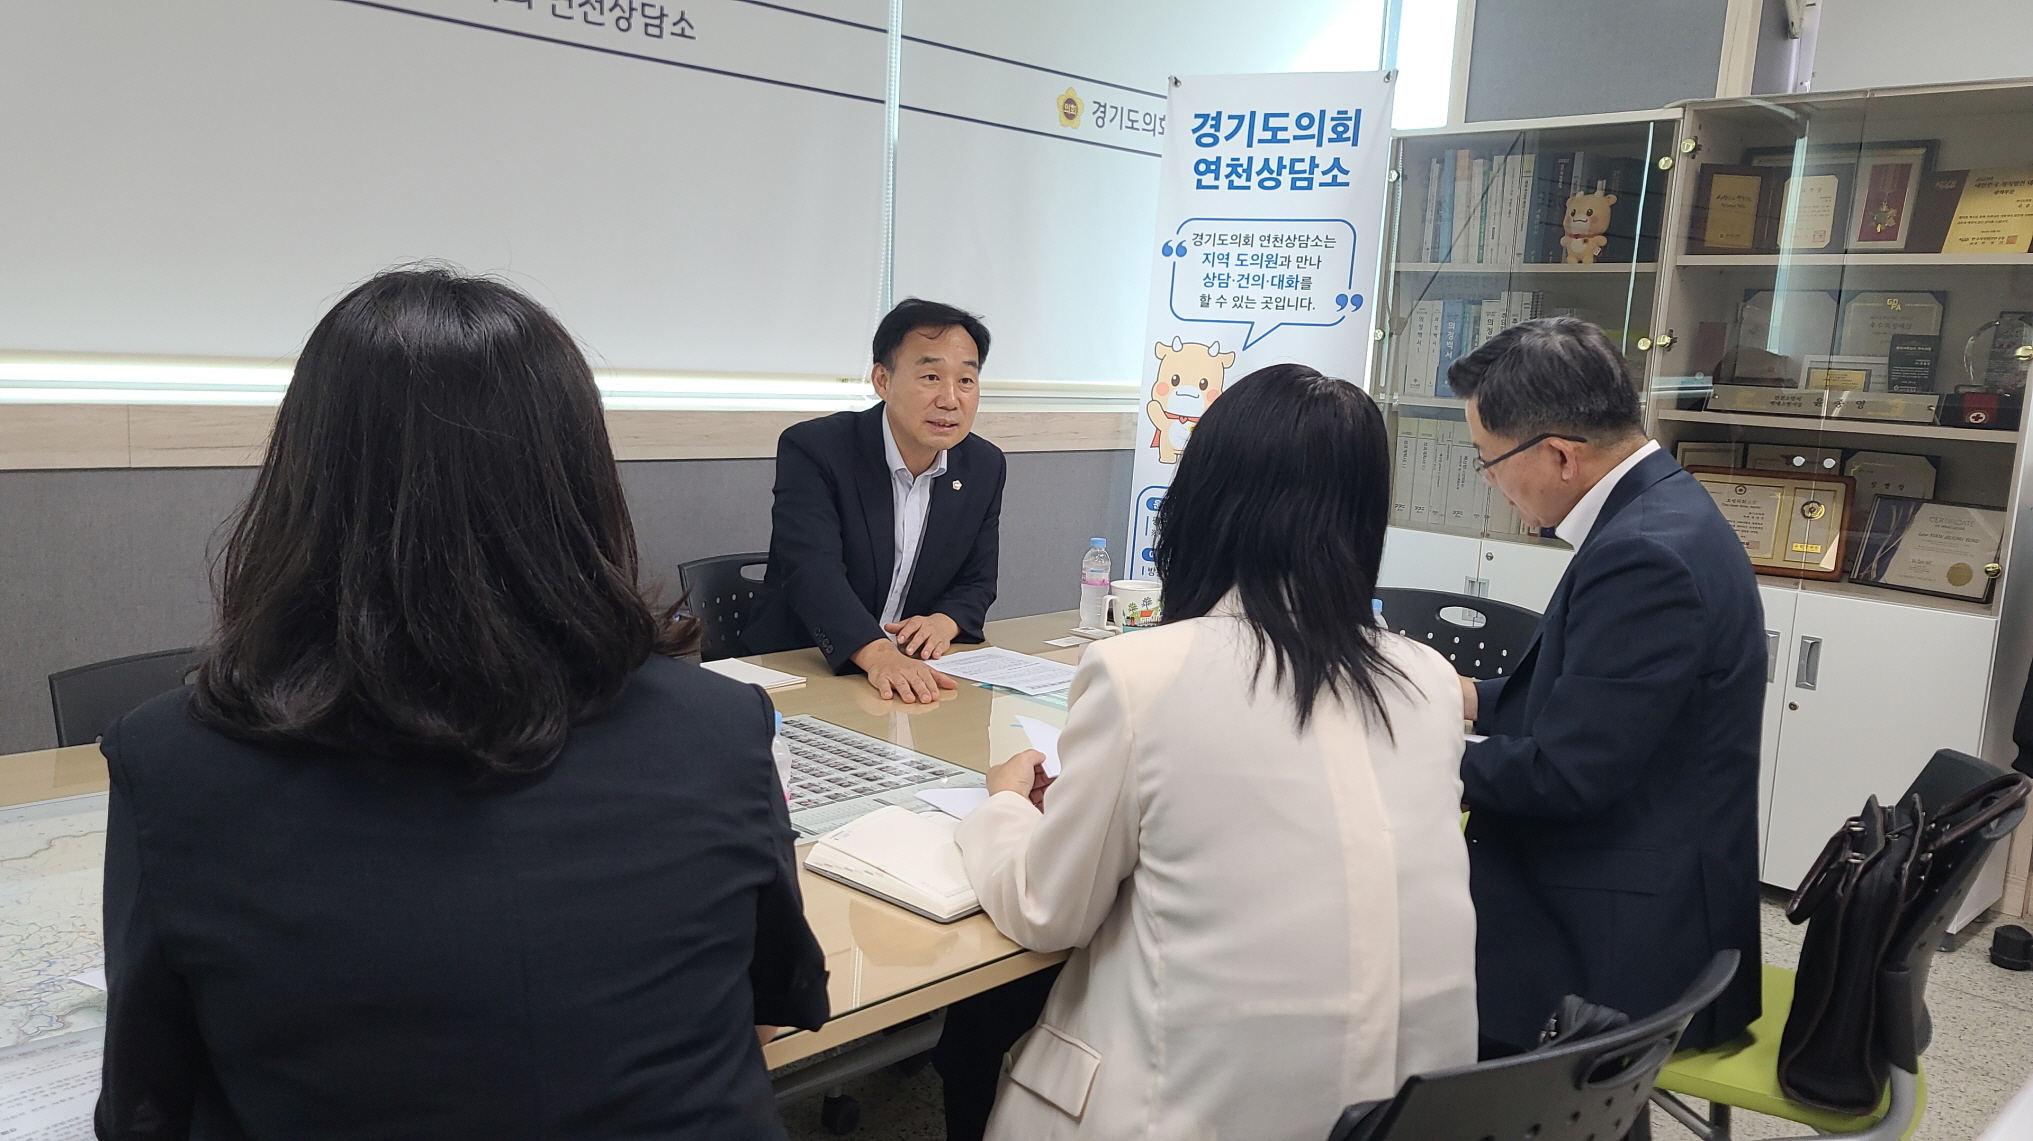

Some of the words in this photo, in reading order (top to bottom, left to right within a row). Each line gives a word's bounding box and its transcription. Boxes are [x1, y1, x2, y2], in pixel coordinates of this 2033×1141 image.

[1191, 108, 1362, 148] 경기도의회
[1193, 156, 1351, 191] 연천상담소
[1192, 232, 1254, 248] 경기도의회
[1259, 233, 1337, 249] 연천상담소는
[1202, 252, 1230, 268] 지역
[1235, 252, 1292, 270] 도의원과
[1296, 254, 1322, 270] 만나
[1202, 272, 1313, 291] 상담·건의·대화를
[1199, 293, 1212, 308] 할
[1215, 294, 1228, 309] 수
[1231, 295, 1257, 309] 있는
[1261, 296, 1316, 311] 곳입니다.
[1445, 321, 1456, 359] 의정백서
